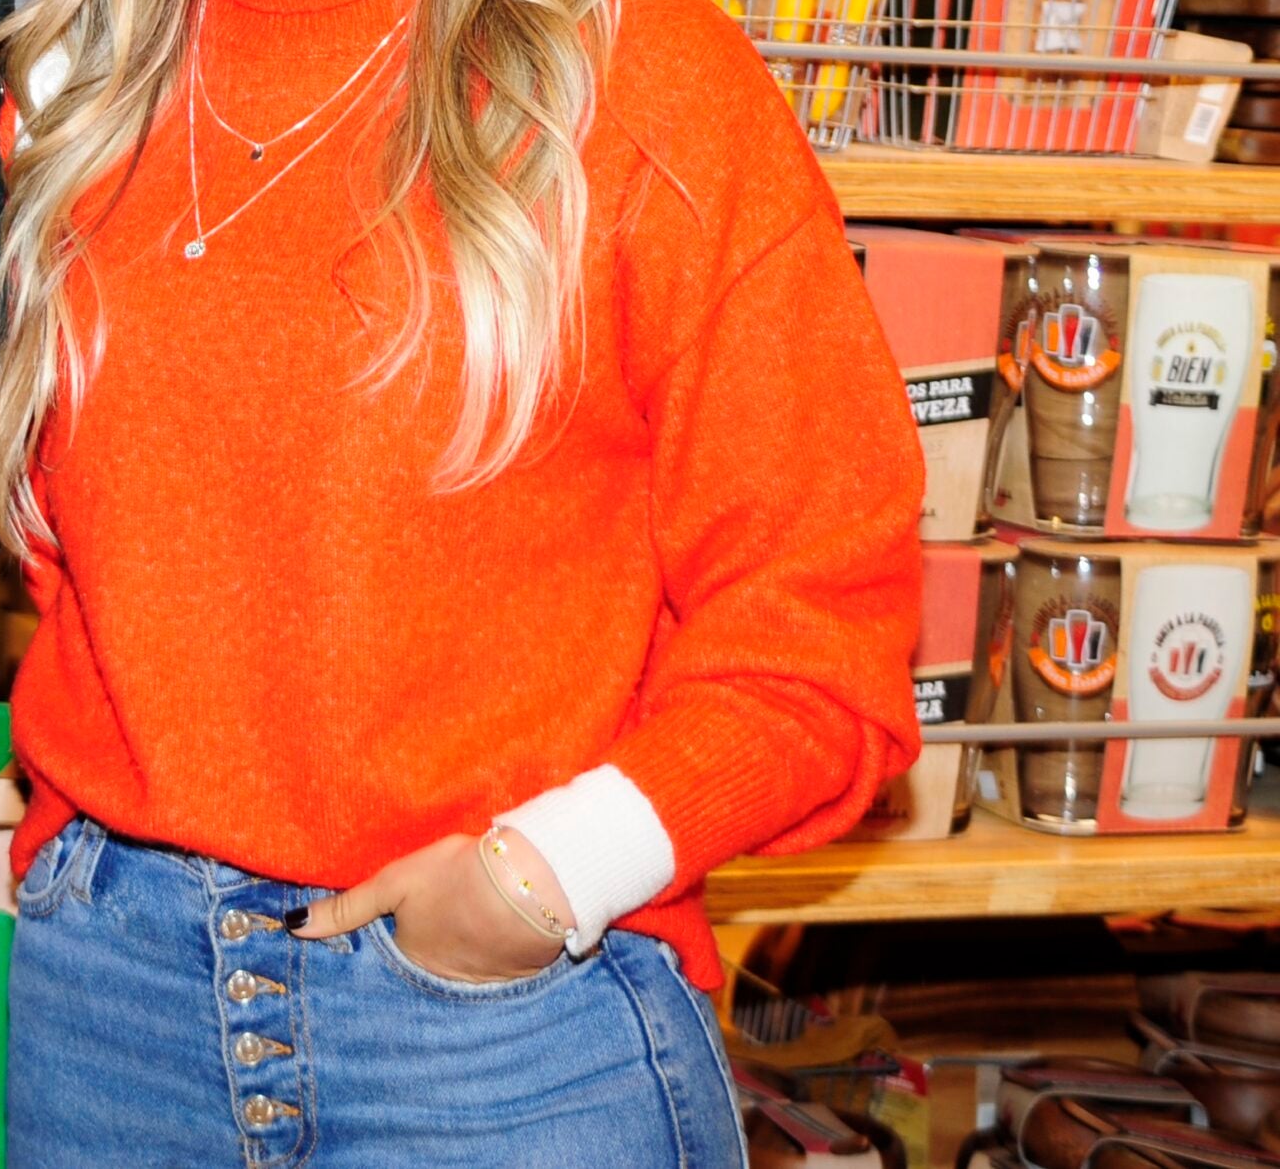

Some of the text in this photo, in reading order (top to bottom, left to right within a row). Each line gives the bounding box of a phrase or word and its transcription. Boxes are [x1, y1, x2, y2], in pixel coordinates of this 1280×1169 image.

[1167, 354, 1212, 384] BIEN
[906, 377, 973, 400] OS PARA
[914, 680, 946, 700] ARA
